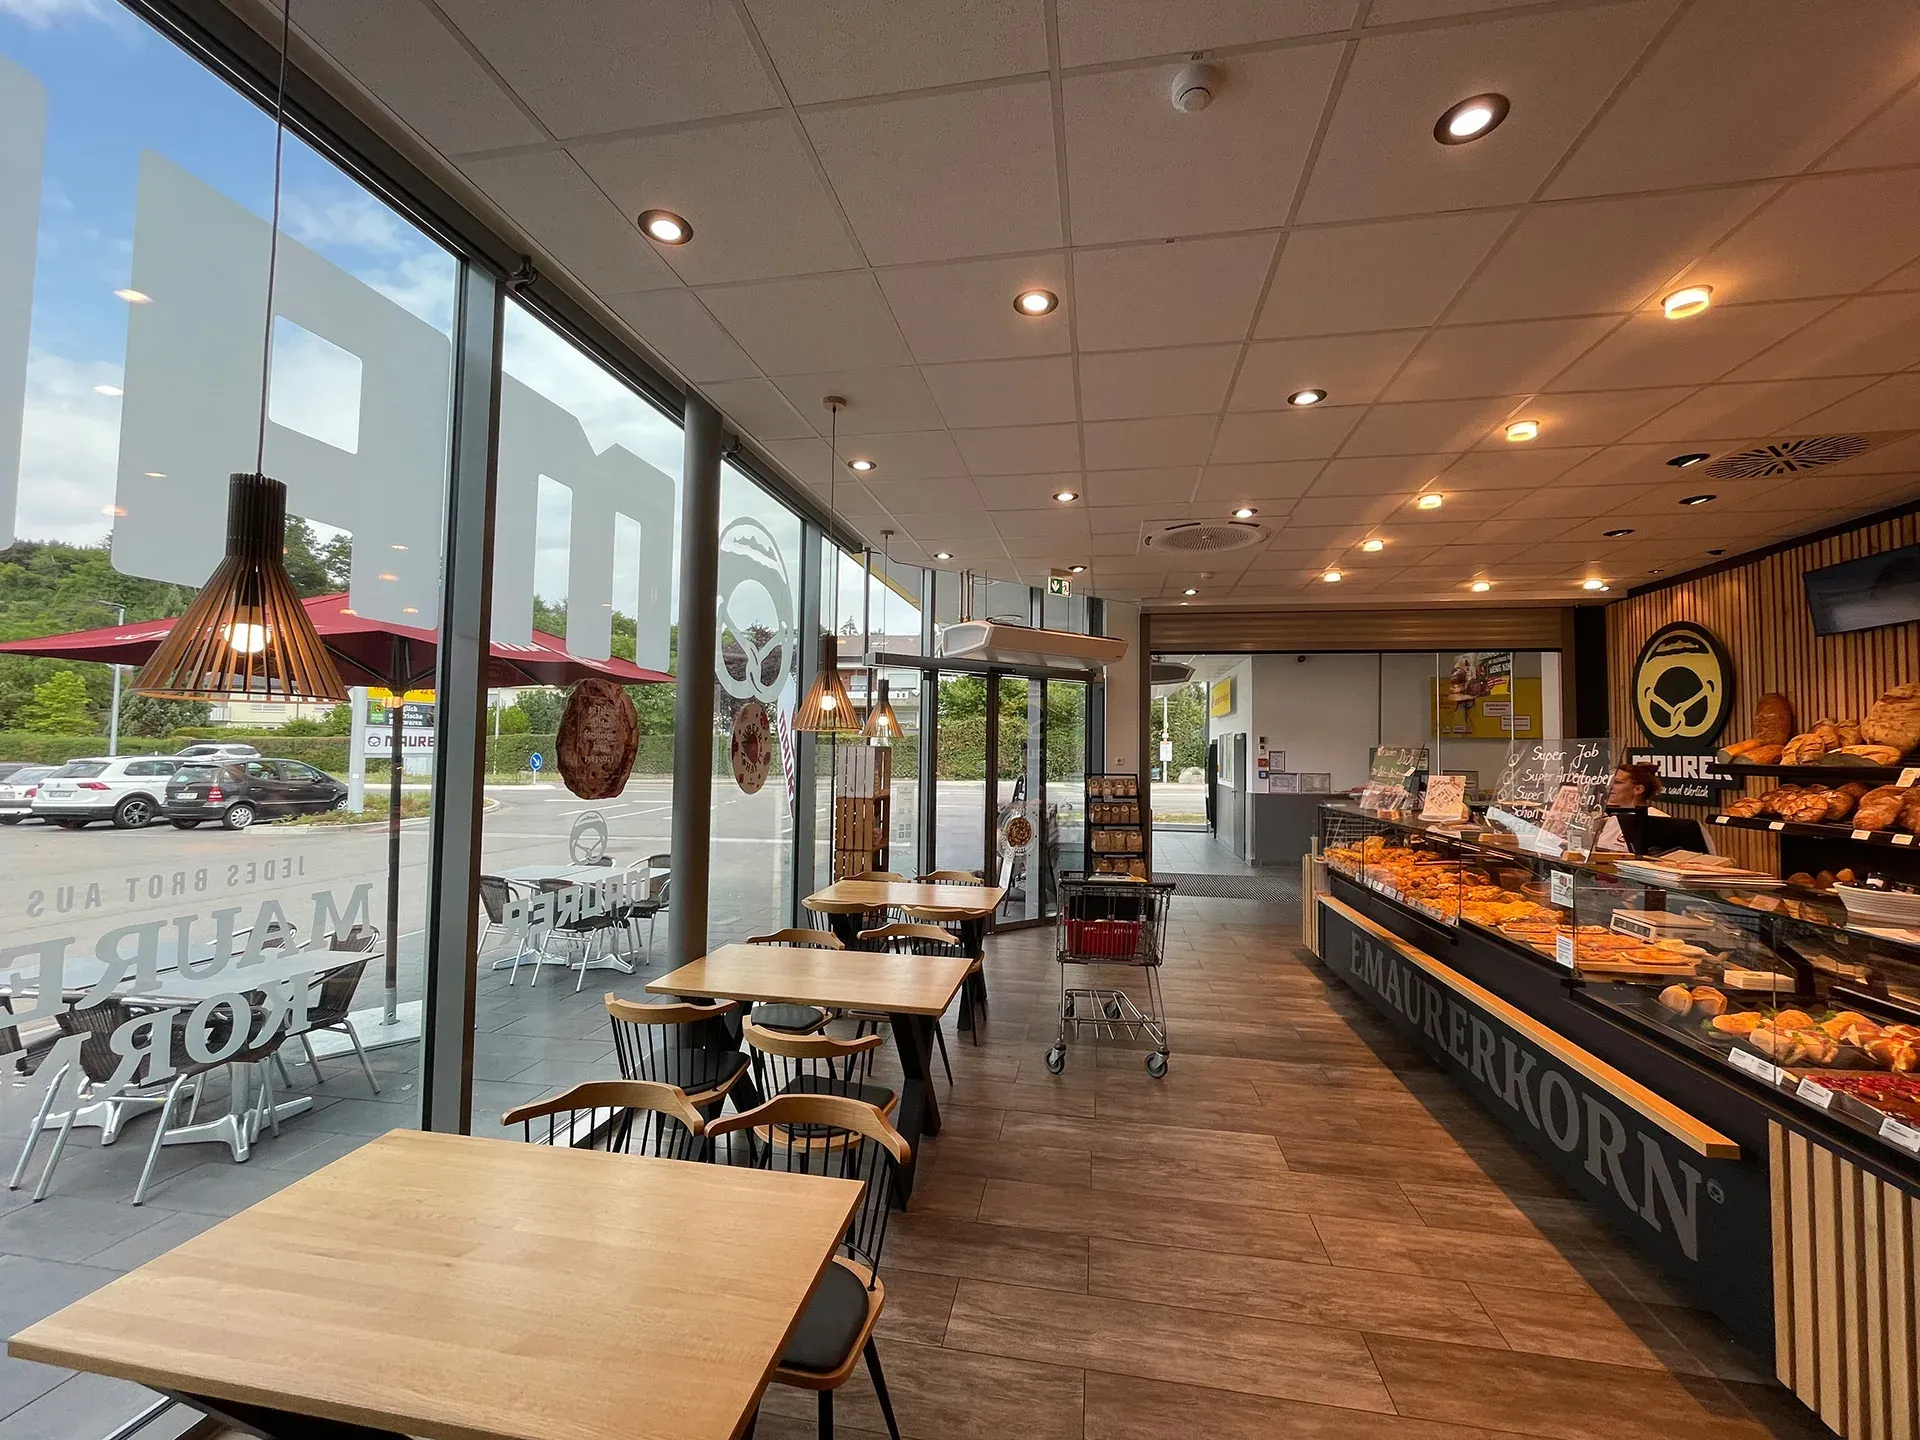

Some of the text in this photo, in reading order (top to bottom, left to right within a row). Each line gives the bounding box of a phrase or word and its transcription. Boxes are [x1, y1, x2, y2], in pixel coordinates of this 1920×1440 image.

[1531, 742, 1599, 769] Super Job
[1522, 768, 1554, 788] Super
[1514, 785, 1543, 804] Super
